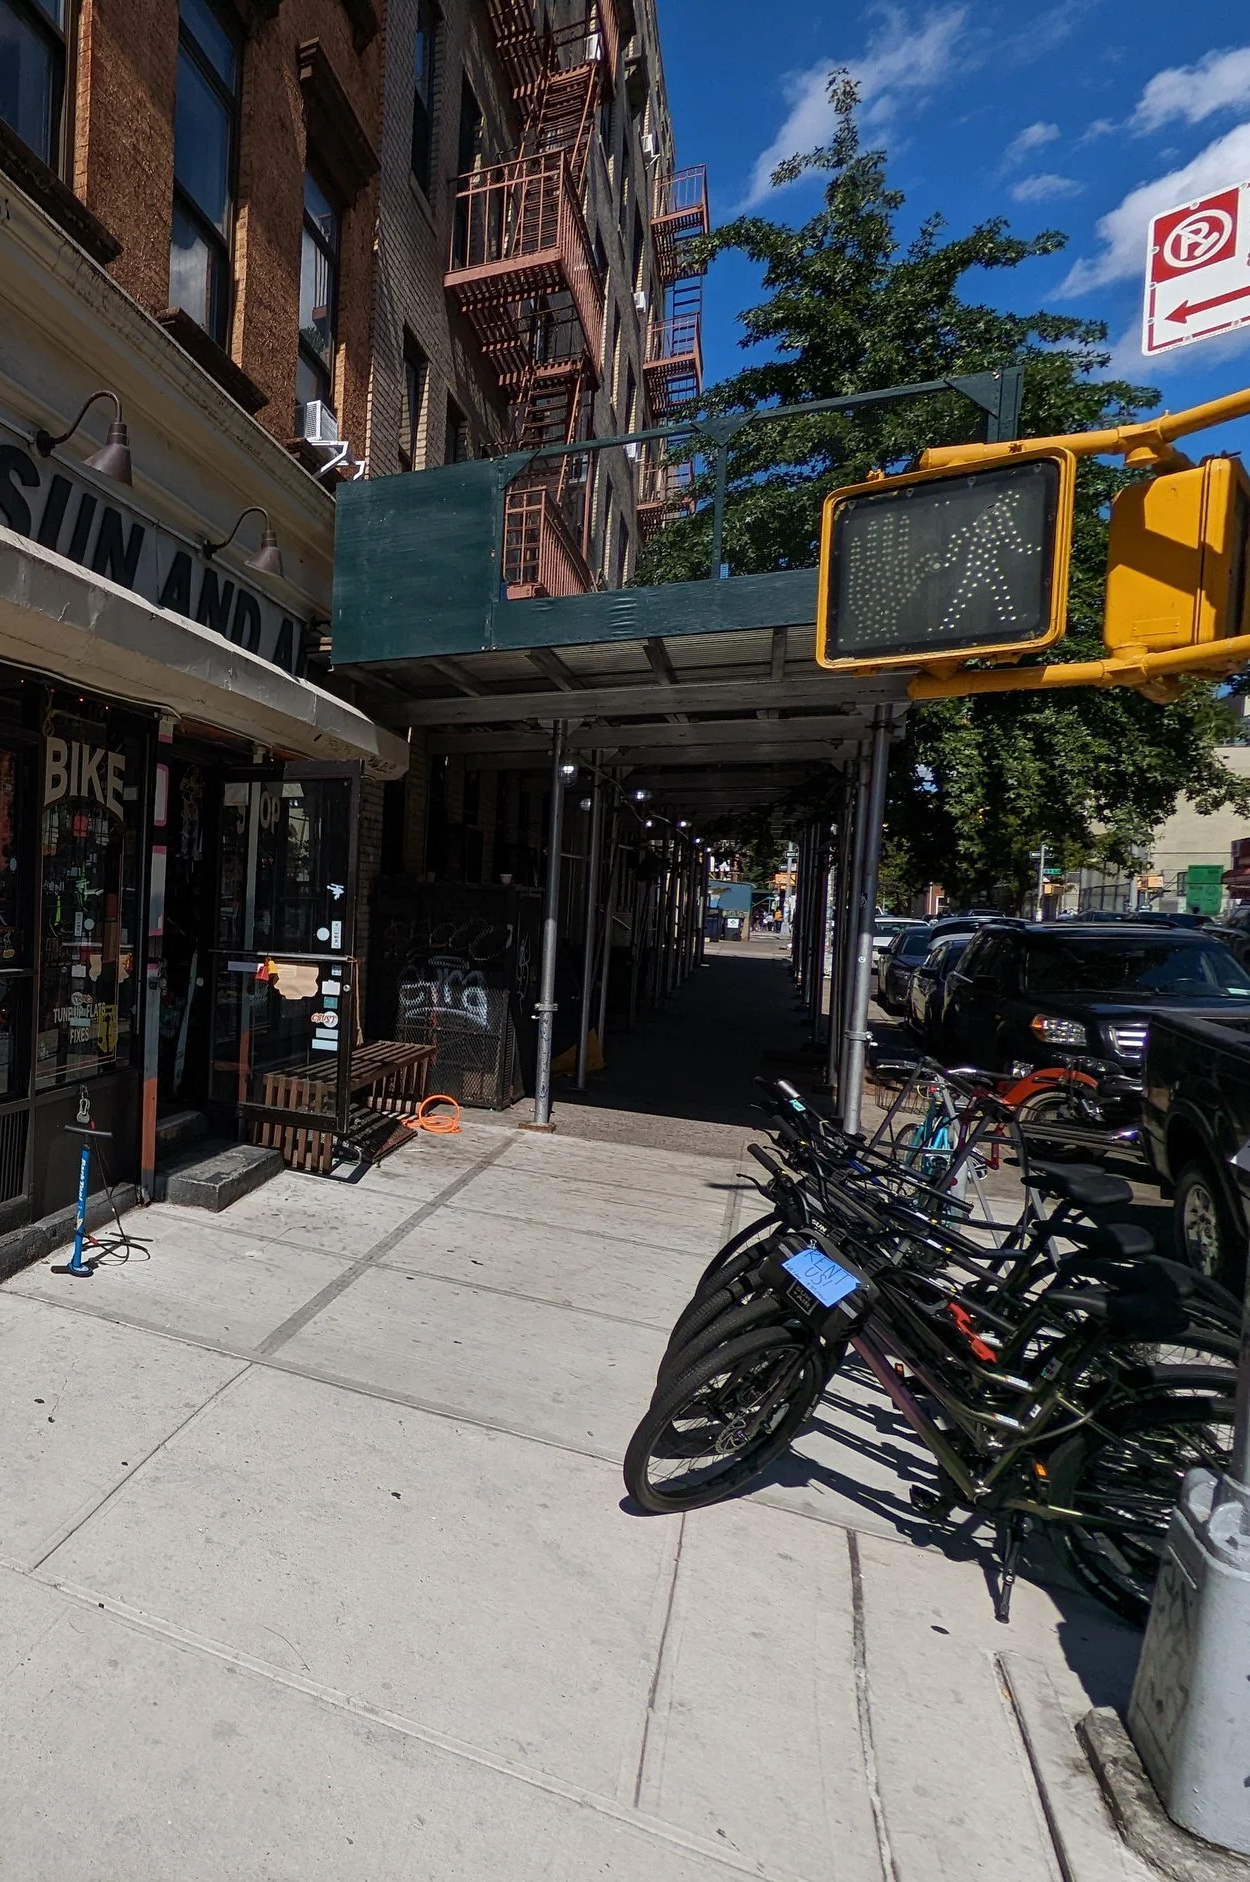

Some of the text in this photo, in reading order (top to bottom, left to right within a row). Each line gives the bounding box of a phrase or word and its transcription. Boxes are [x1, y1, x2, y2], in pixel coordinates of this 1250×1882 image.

[158, 551, 262, 656] AND
[43, 735, 127, 823] BIKE
[70, 1027, 90, 1045] FIXES
[811, 1219, 828, 1233] SUN
[804, 1249, 855, 1286] RENT
